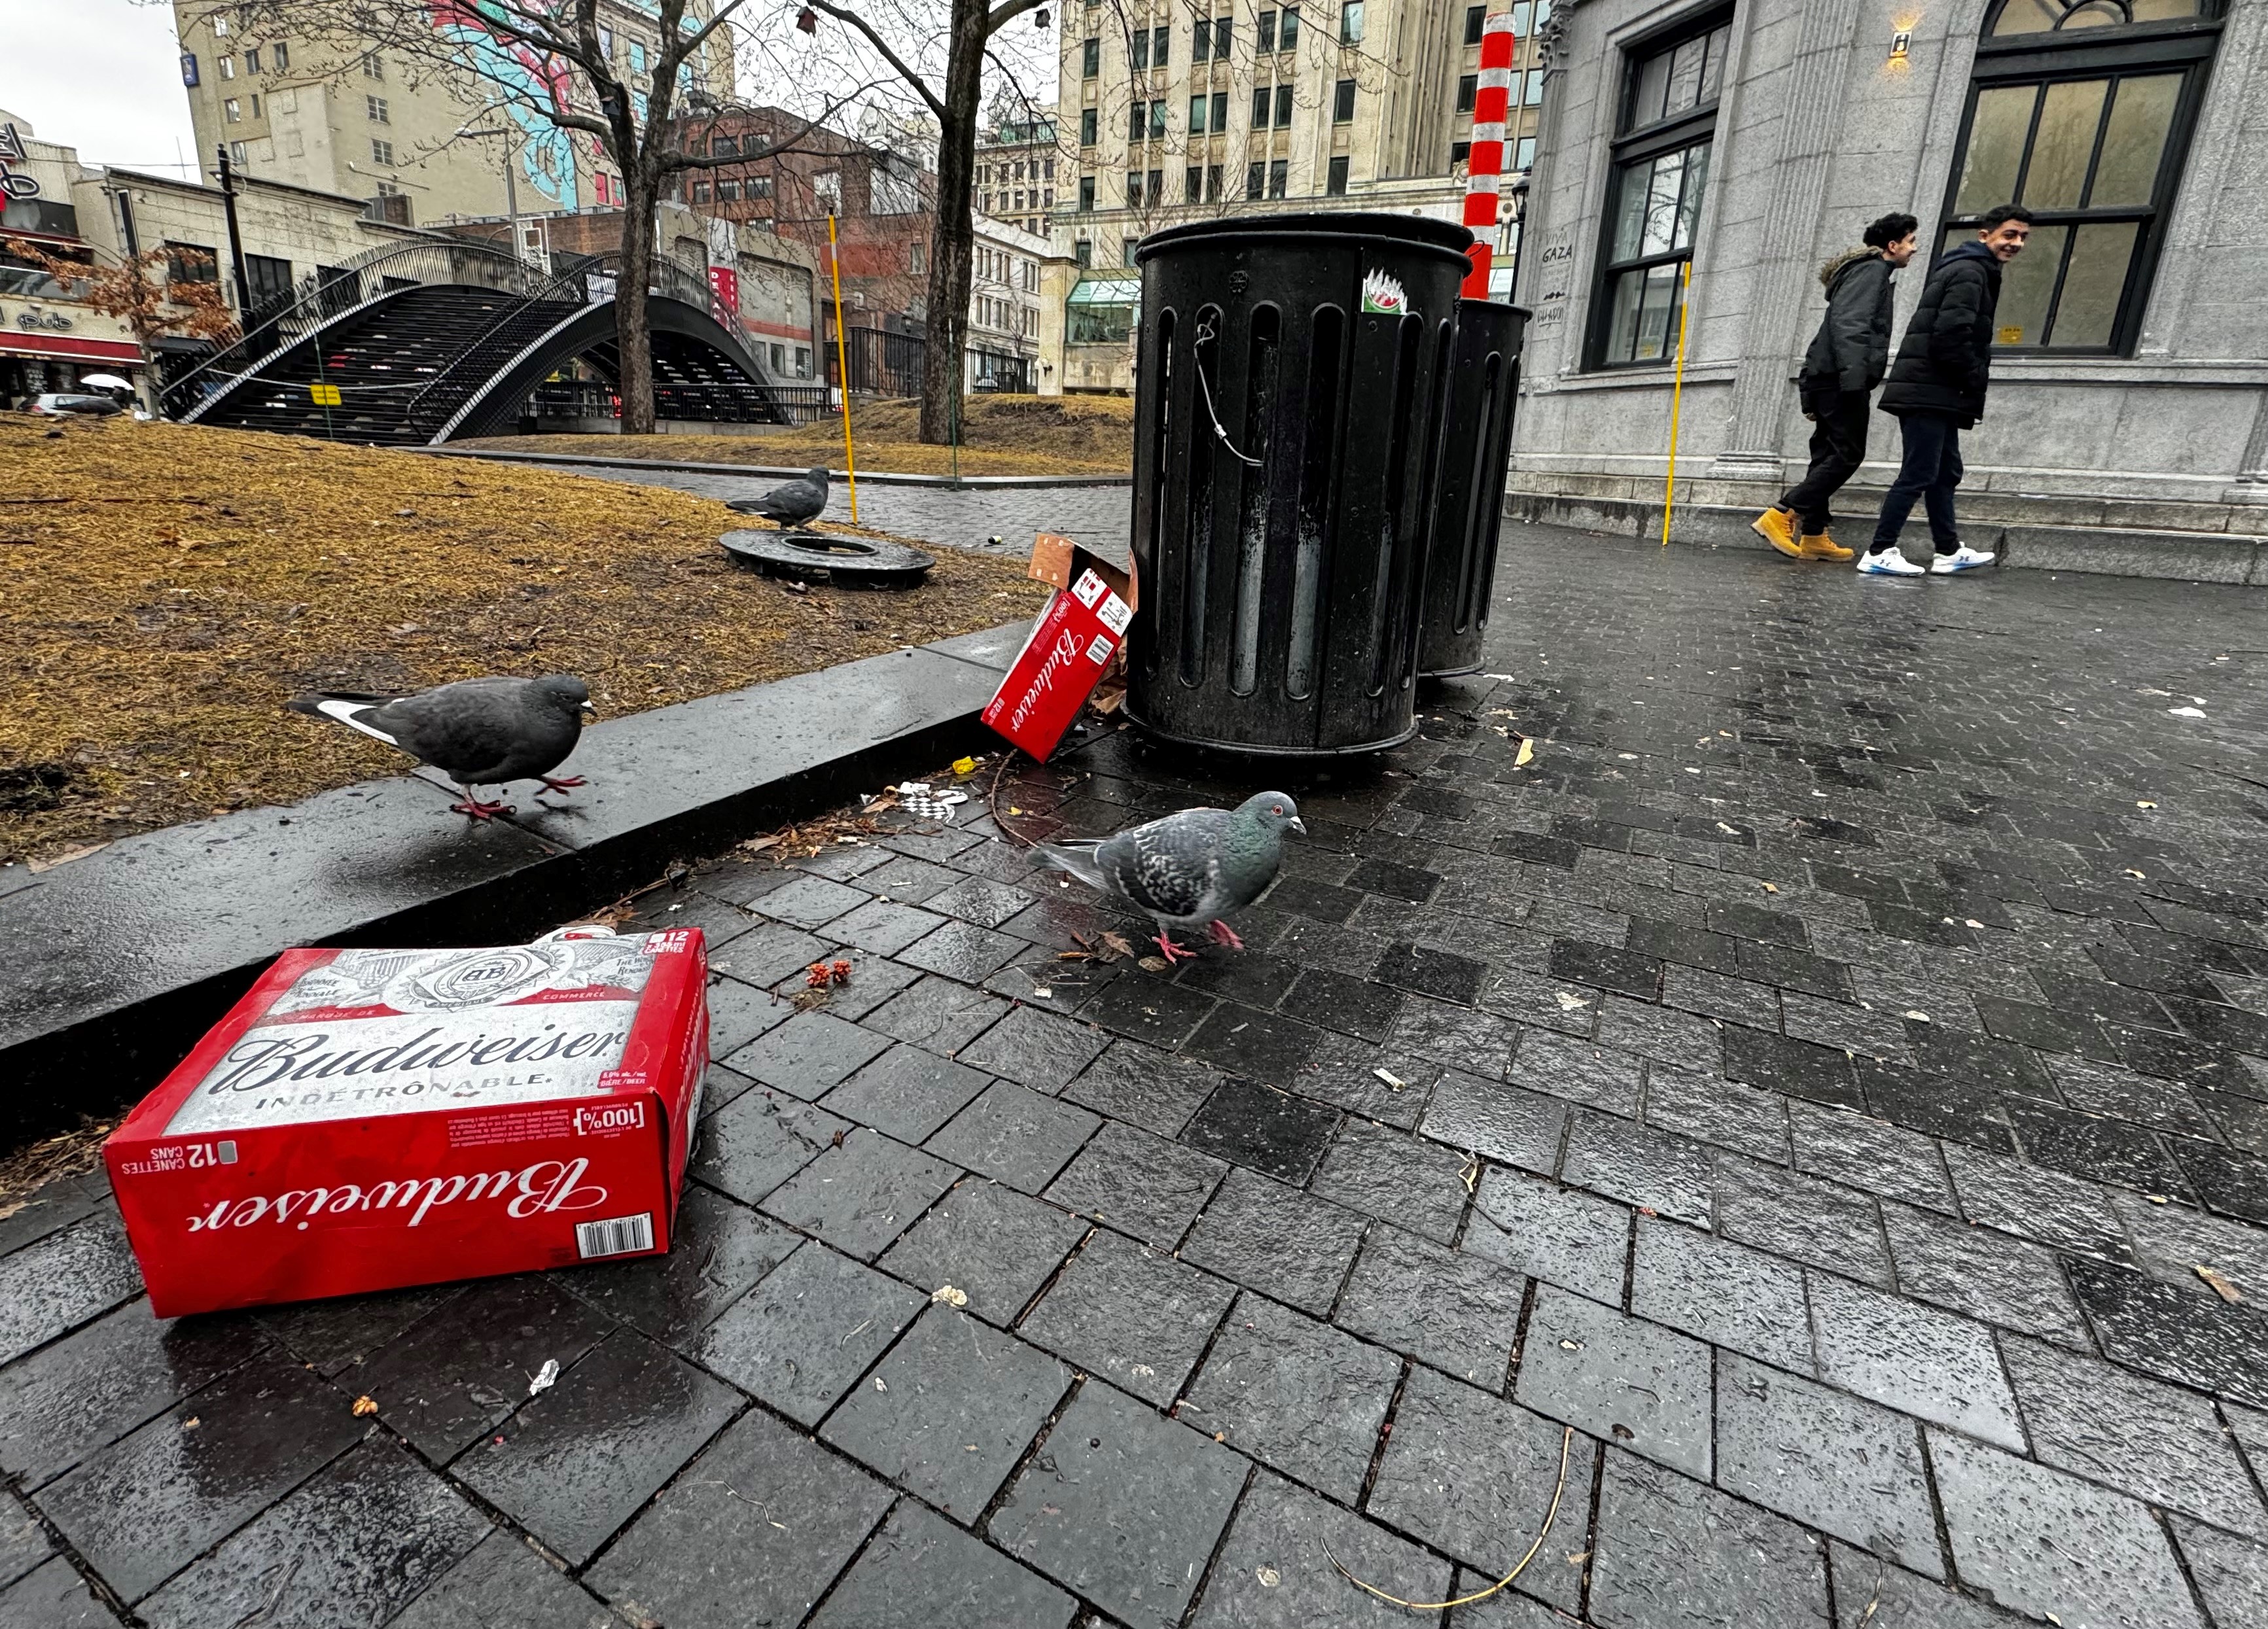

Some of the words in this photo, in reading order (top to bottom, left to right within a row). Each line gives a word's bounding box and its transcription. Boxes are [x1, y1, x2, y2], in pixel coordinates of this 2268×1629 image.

[1542, 243, 1572, 263] GAZA
[1011, 627, 1084, 733] Budweiser
[668, 931, 690, 942] 12
[461, 966, 506, 982] AB
[542, 990, 605, 1000] COMMERCE
[209, 1026, 625, 1095] Budweiser
[150, 1146, 184, 1161] CANS
[186, 1143, 218, 1168] 12
[120, 1157, 186, 1175] CANETTES
[187, 1157, 607, 1231] Budweiser
